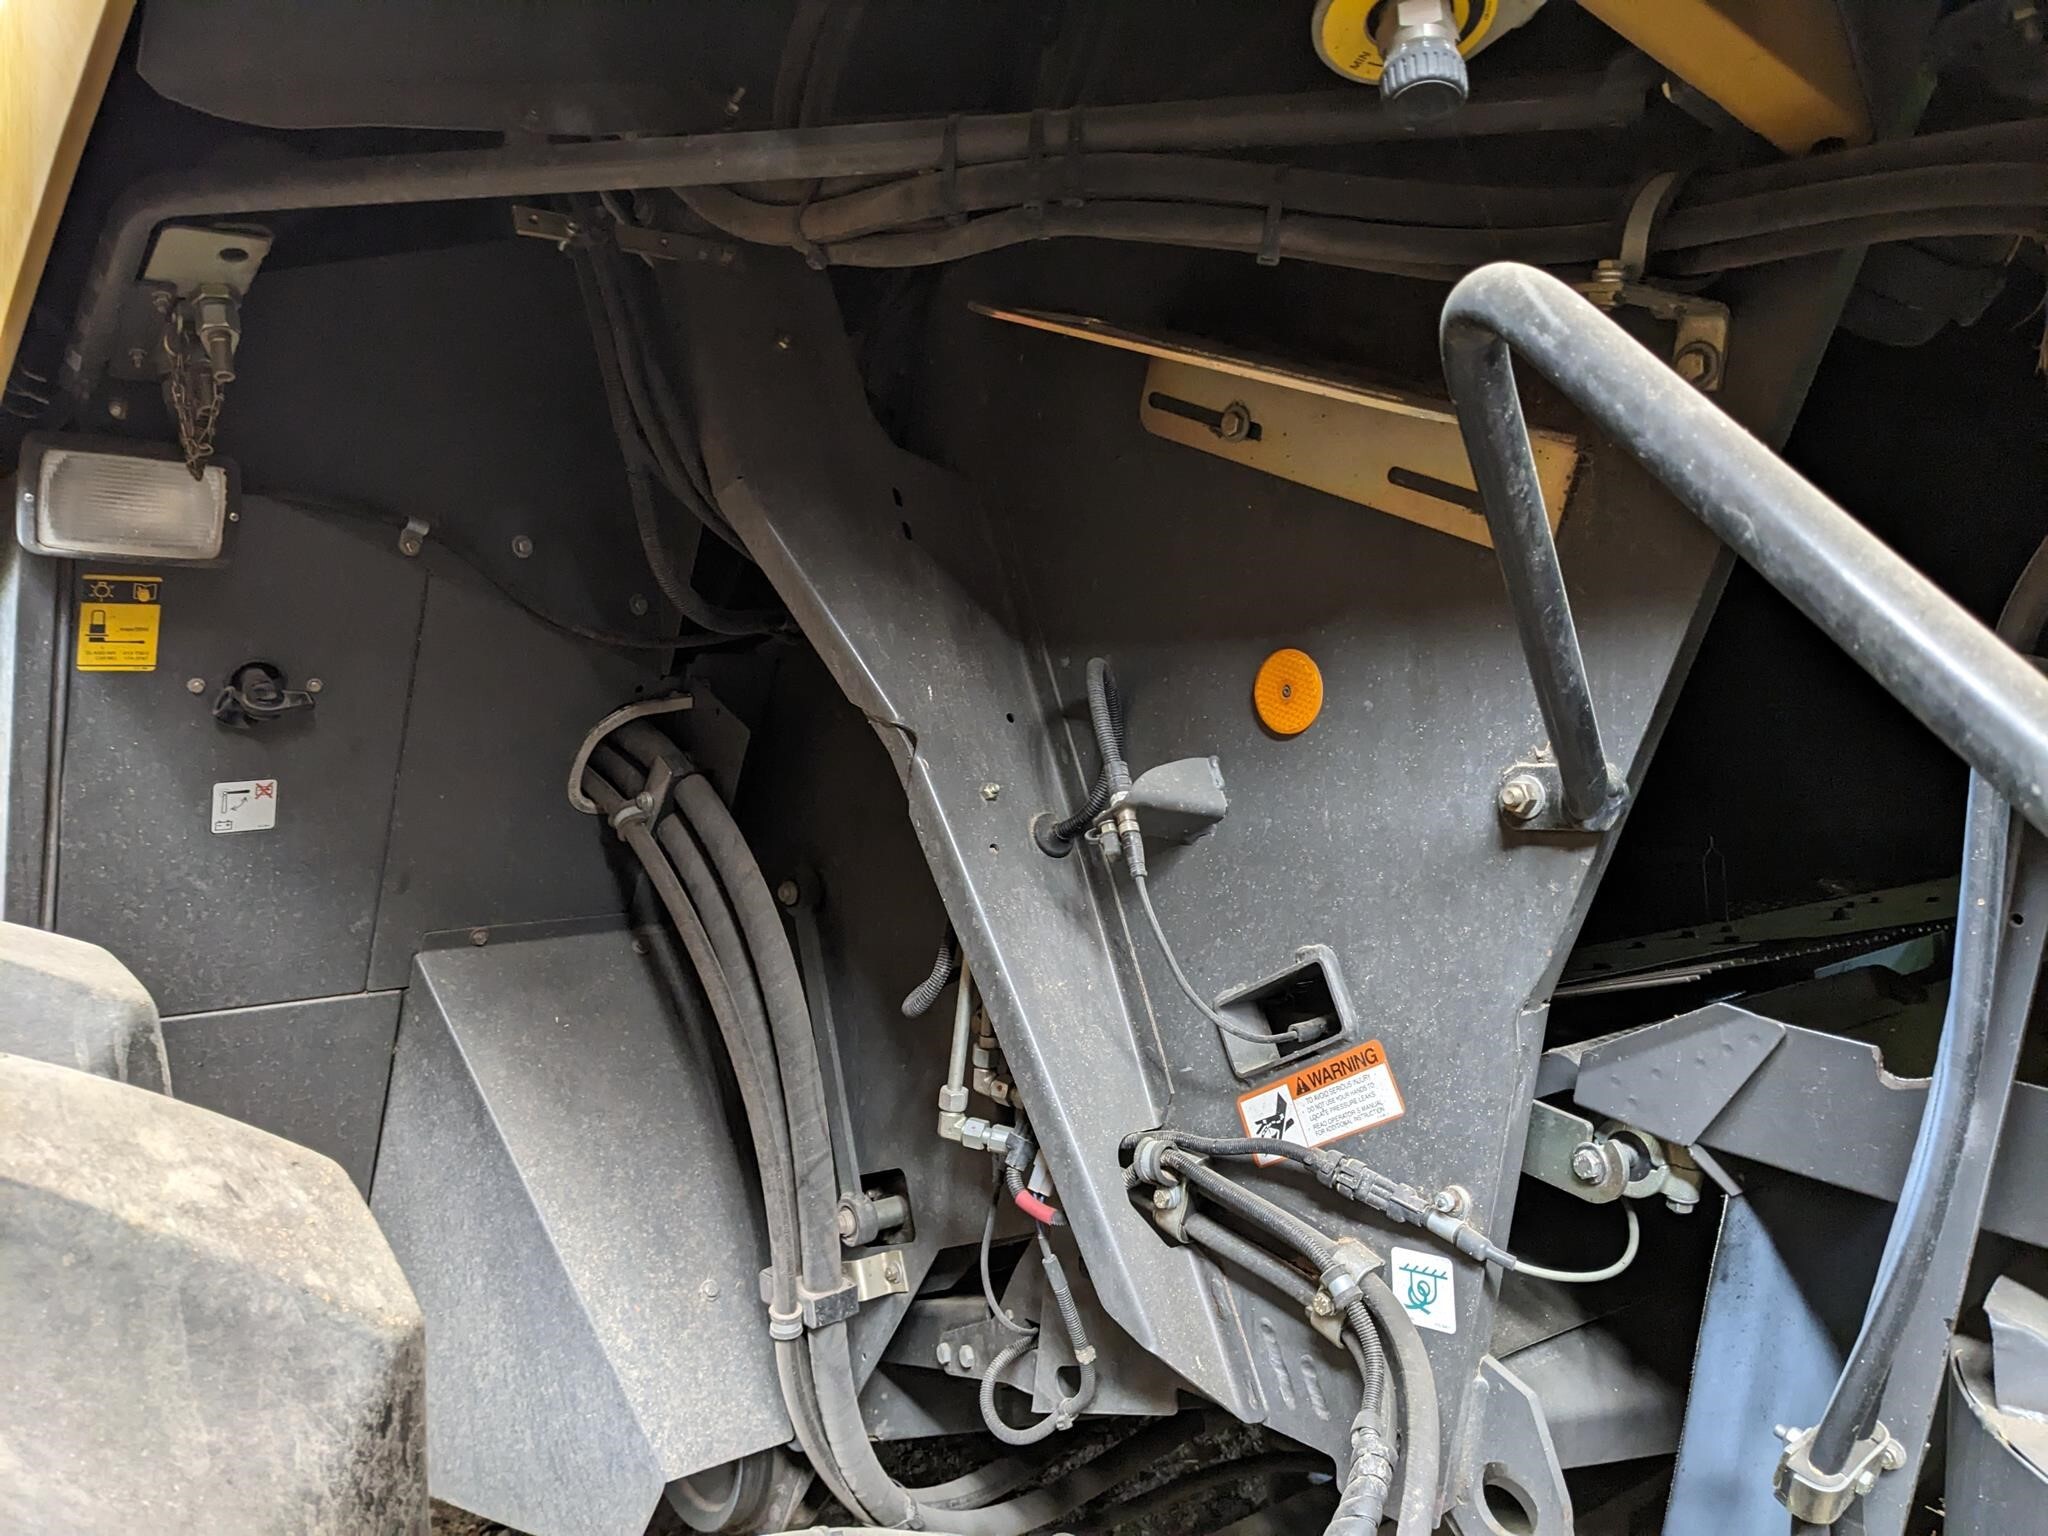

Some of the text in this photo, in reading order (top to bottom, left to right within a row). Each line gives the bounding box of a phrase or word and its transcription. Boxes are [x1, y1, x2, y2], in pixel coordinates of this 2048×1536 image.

[1349, 51, 1371, 70] MIN
[1307, 1048, 1378, 1088] WARNING
[1314, 1090, 1329, 1101] AVOID
[1329, 1081, 1352, 1094] SERIOUS
[1353, 1074, 1370, 1086] INJURY
[1315, 1101, 1325, 1110] NOT
[1326, 1097, 1336, 1106] USE
[1336, 1091, 1350, 1101] YOUR
[1350, 1085, 1368, 1096] HANDS
[1309, 1108, 1329, 1122] LOCATE
[1330, 1098, 1358, 1113] PRESSURE
[1312, 1119, 1328, 1130] READ
[1315, 1128, 1326, 1137] FOR
[1326, 1119, 1353, 1132] ADDITIONAL
